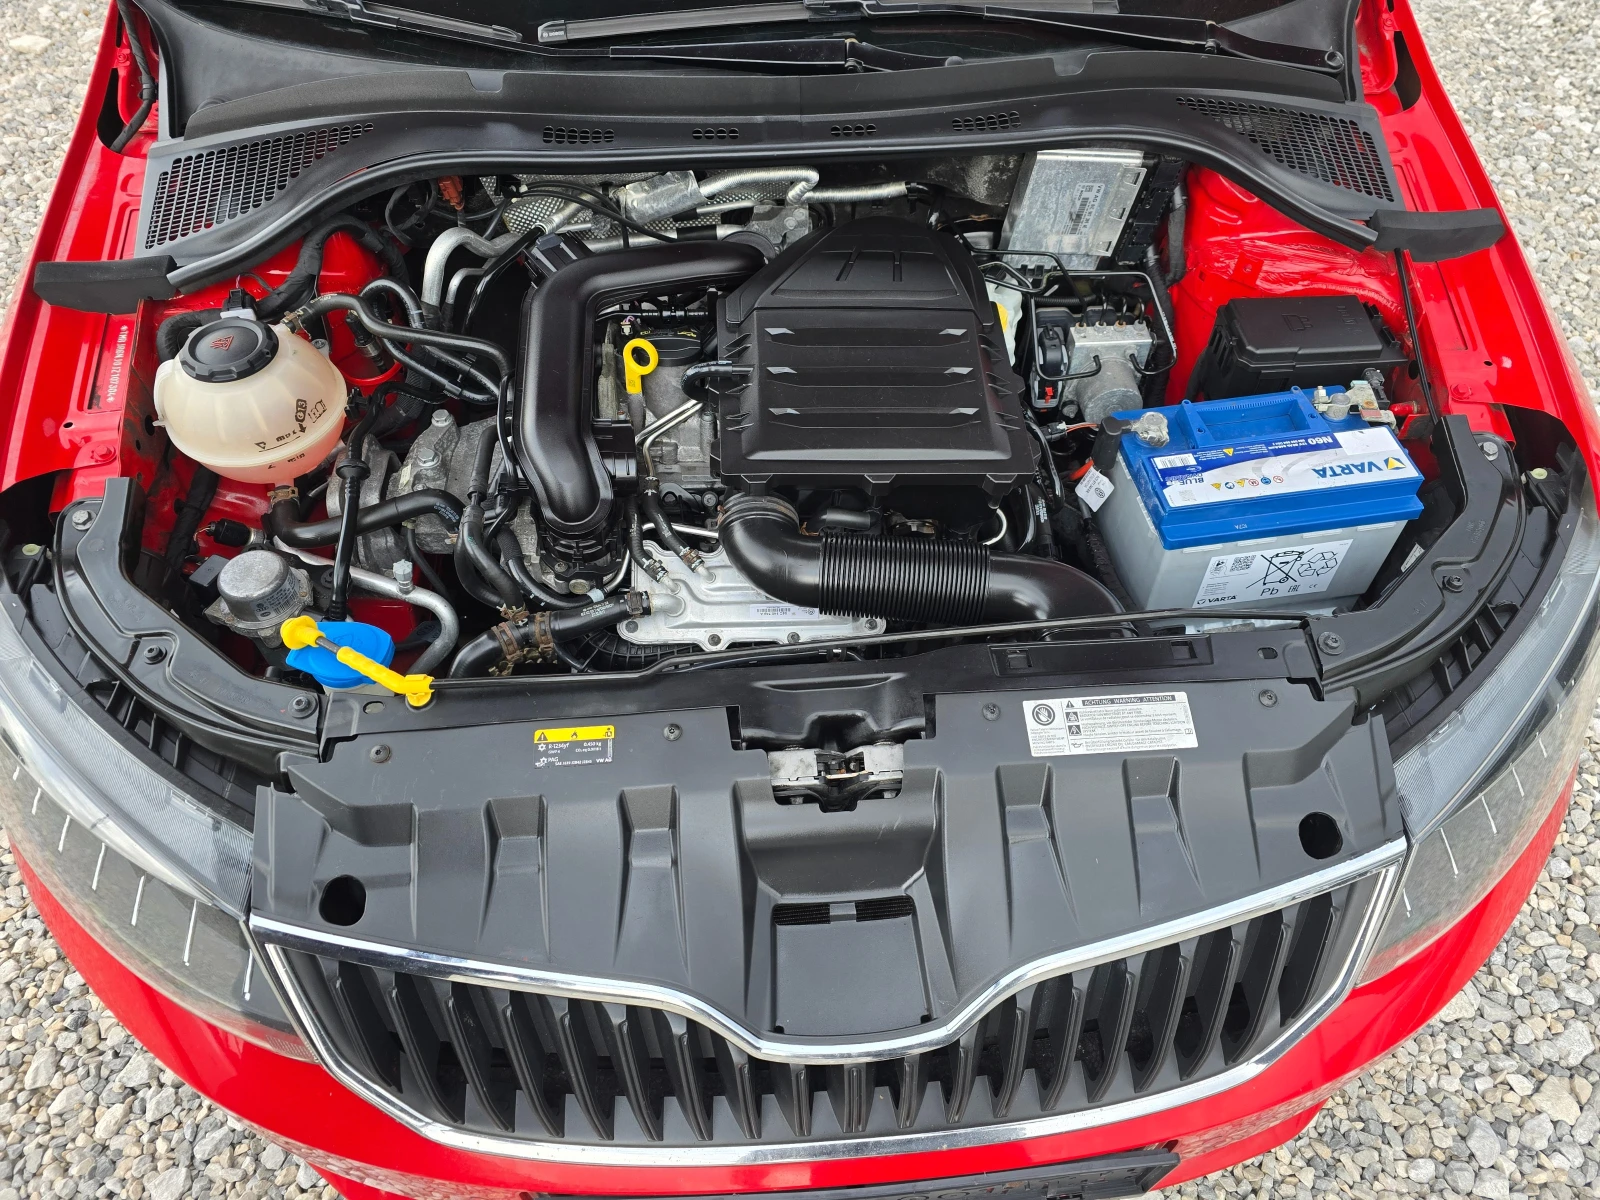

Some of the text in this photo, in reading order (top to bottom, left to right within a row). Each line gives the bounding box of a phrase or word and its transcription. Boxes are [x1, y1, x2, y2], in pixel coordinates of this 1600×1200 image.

[1308, 435, 1333, 445] N60
[1311, 460, 1383, 479] VARTA
[1180, 477, 1204, 486] BLUE
[1260, 587, 1279, 596] Pb
[1208, 594, 1237, 603] VARTA
[1143, 695, 1173, 703] ATTENTION
